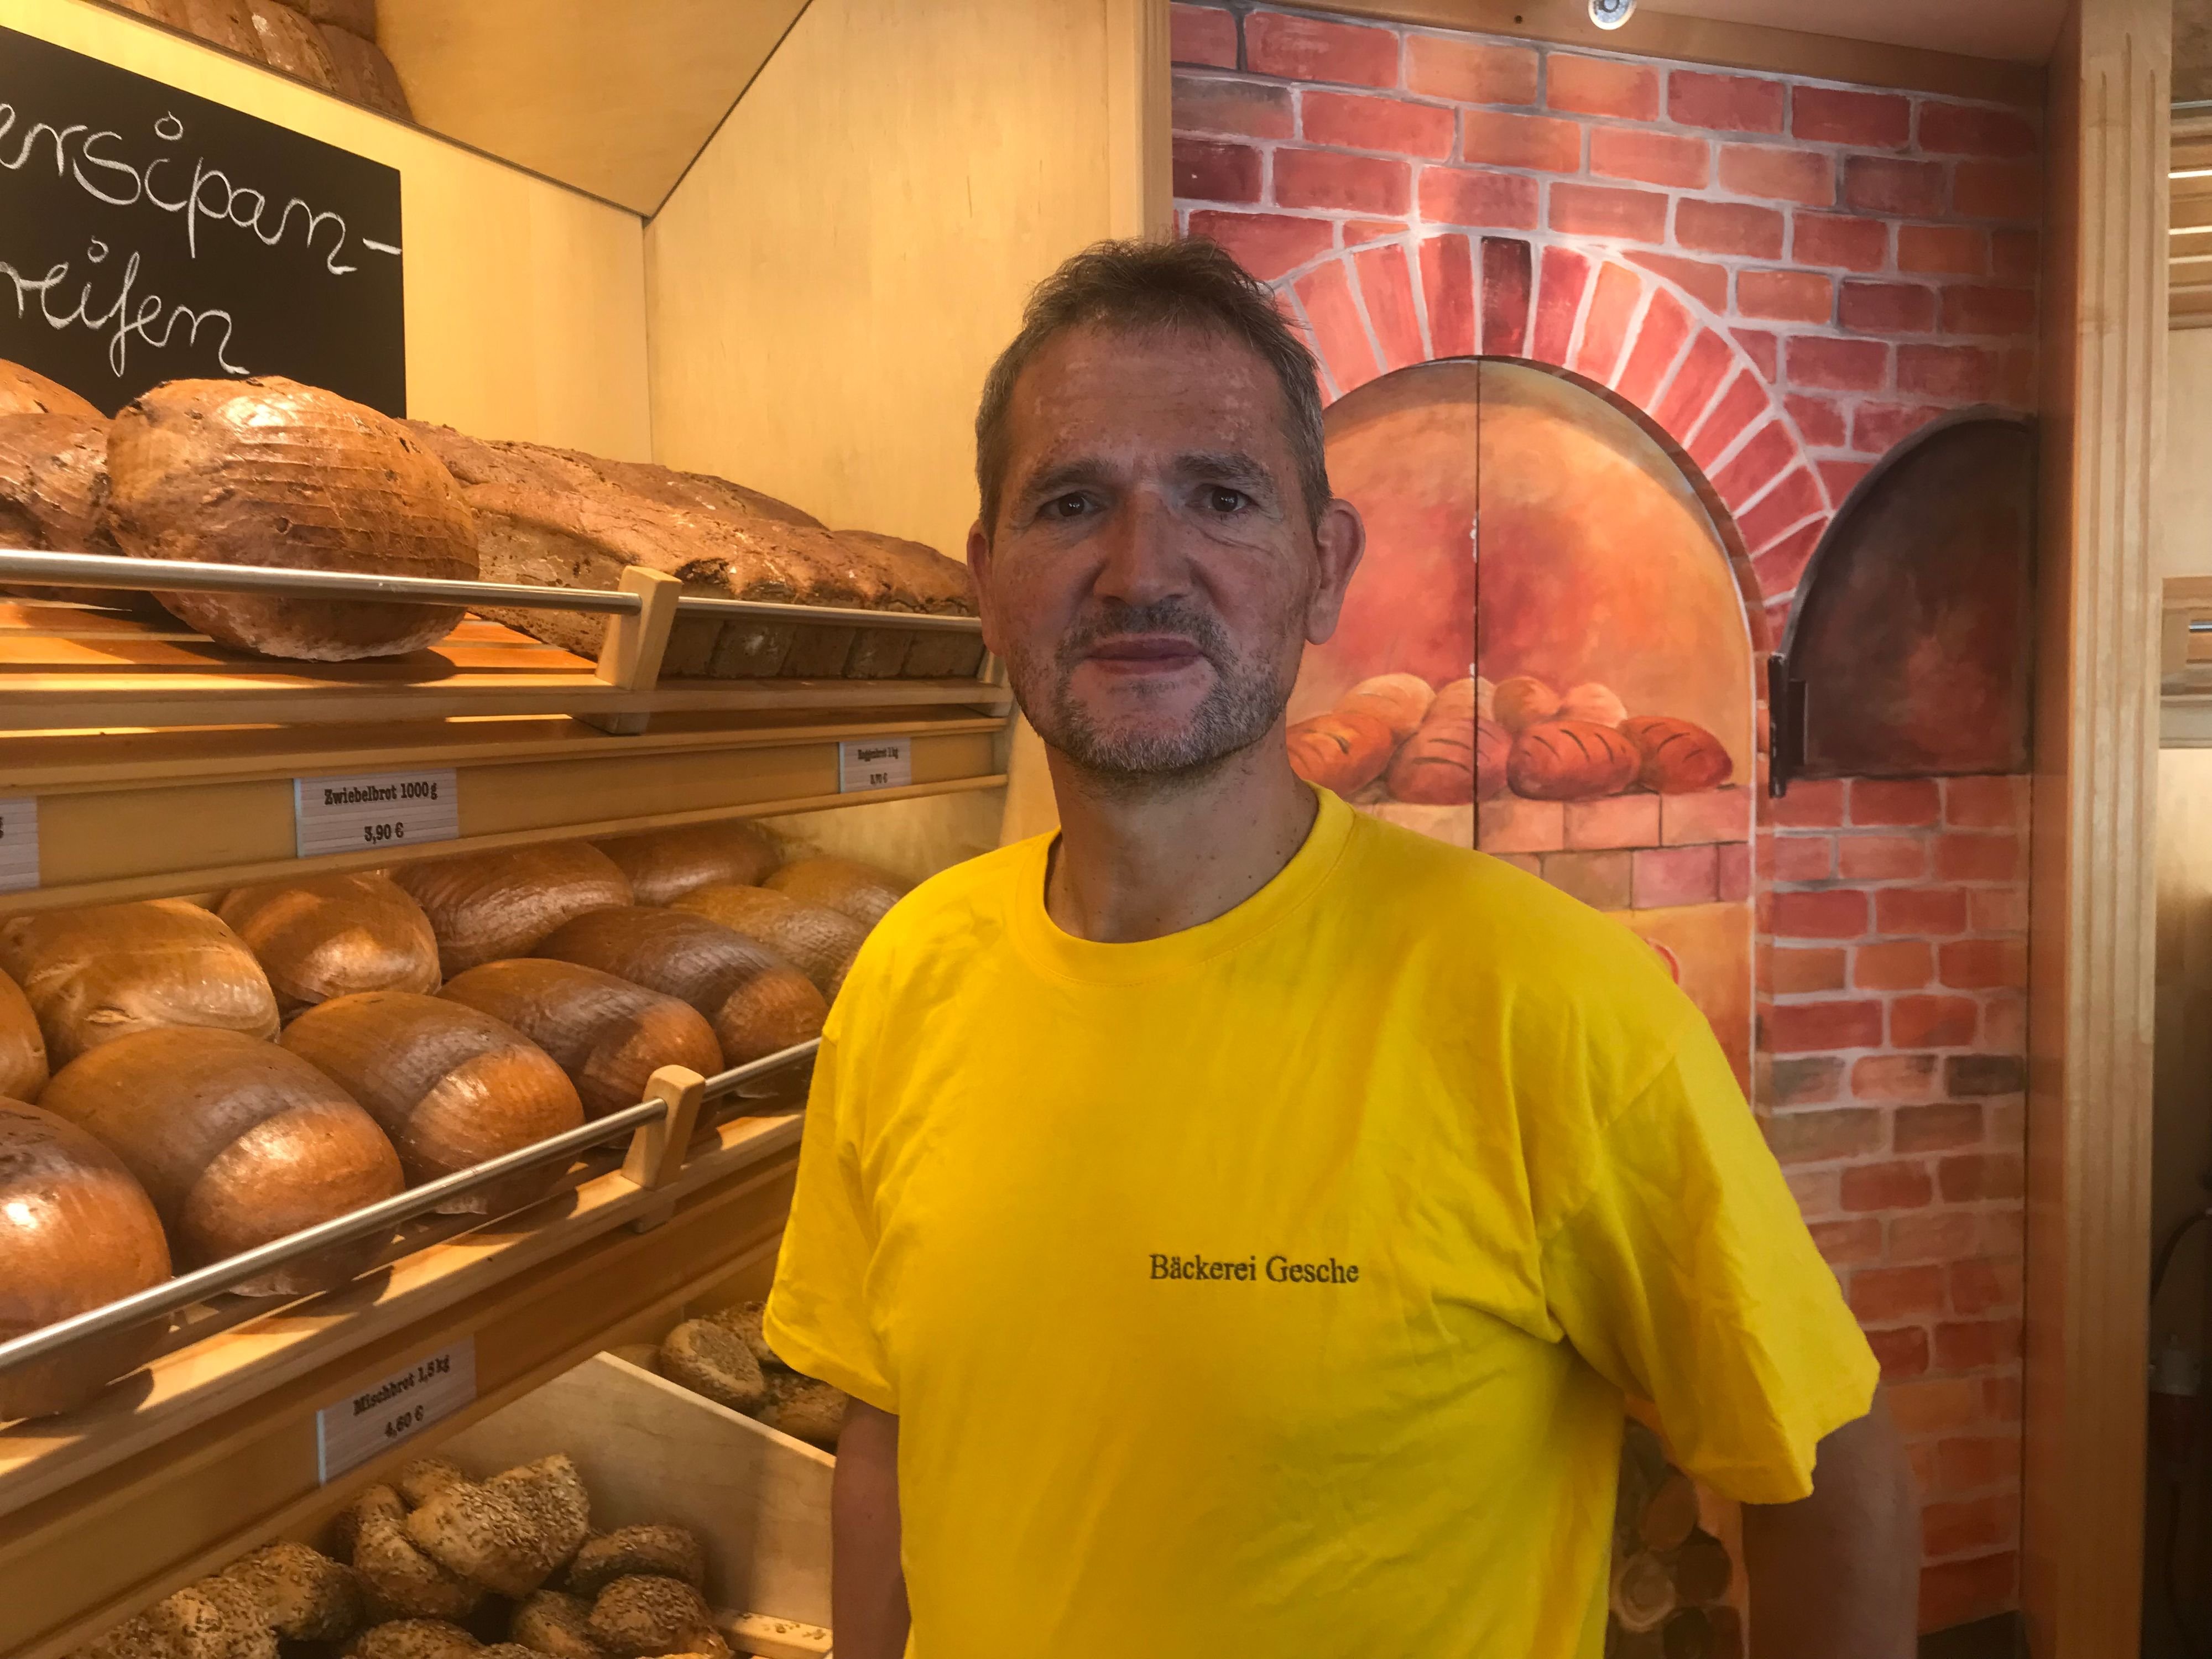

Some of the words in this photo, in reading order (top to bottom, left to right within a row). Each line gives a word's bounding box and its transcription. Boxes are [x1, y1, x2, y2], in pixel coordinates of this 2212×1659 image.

[324, 785, 397, 805] Zwiebelbrot
[395, 822, 404, 838] €
[1149, 1253, 1257, 1281] Bäckerei
[1265, 1255, 1360, 1284] Gesche
[353, 1373, 415, 1416] Mischbrot
[415, 1405, 425, 1421] €
